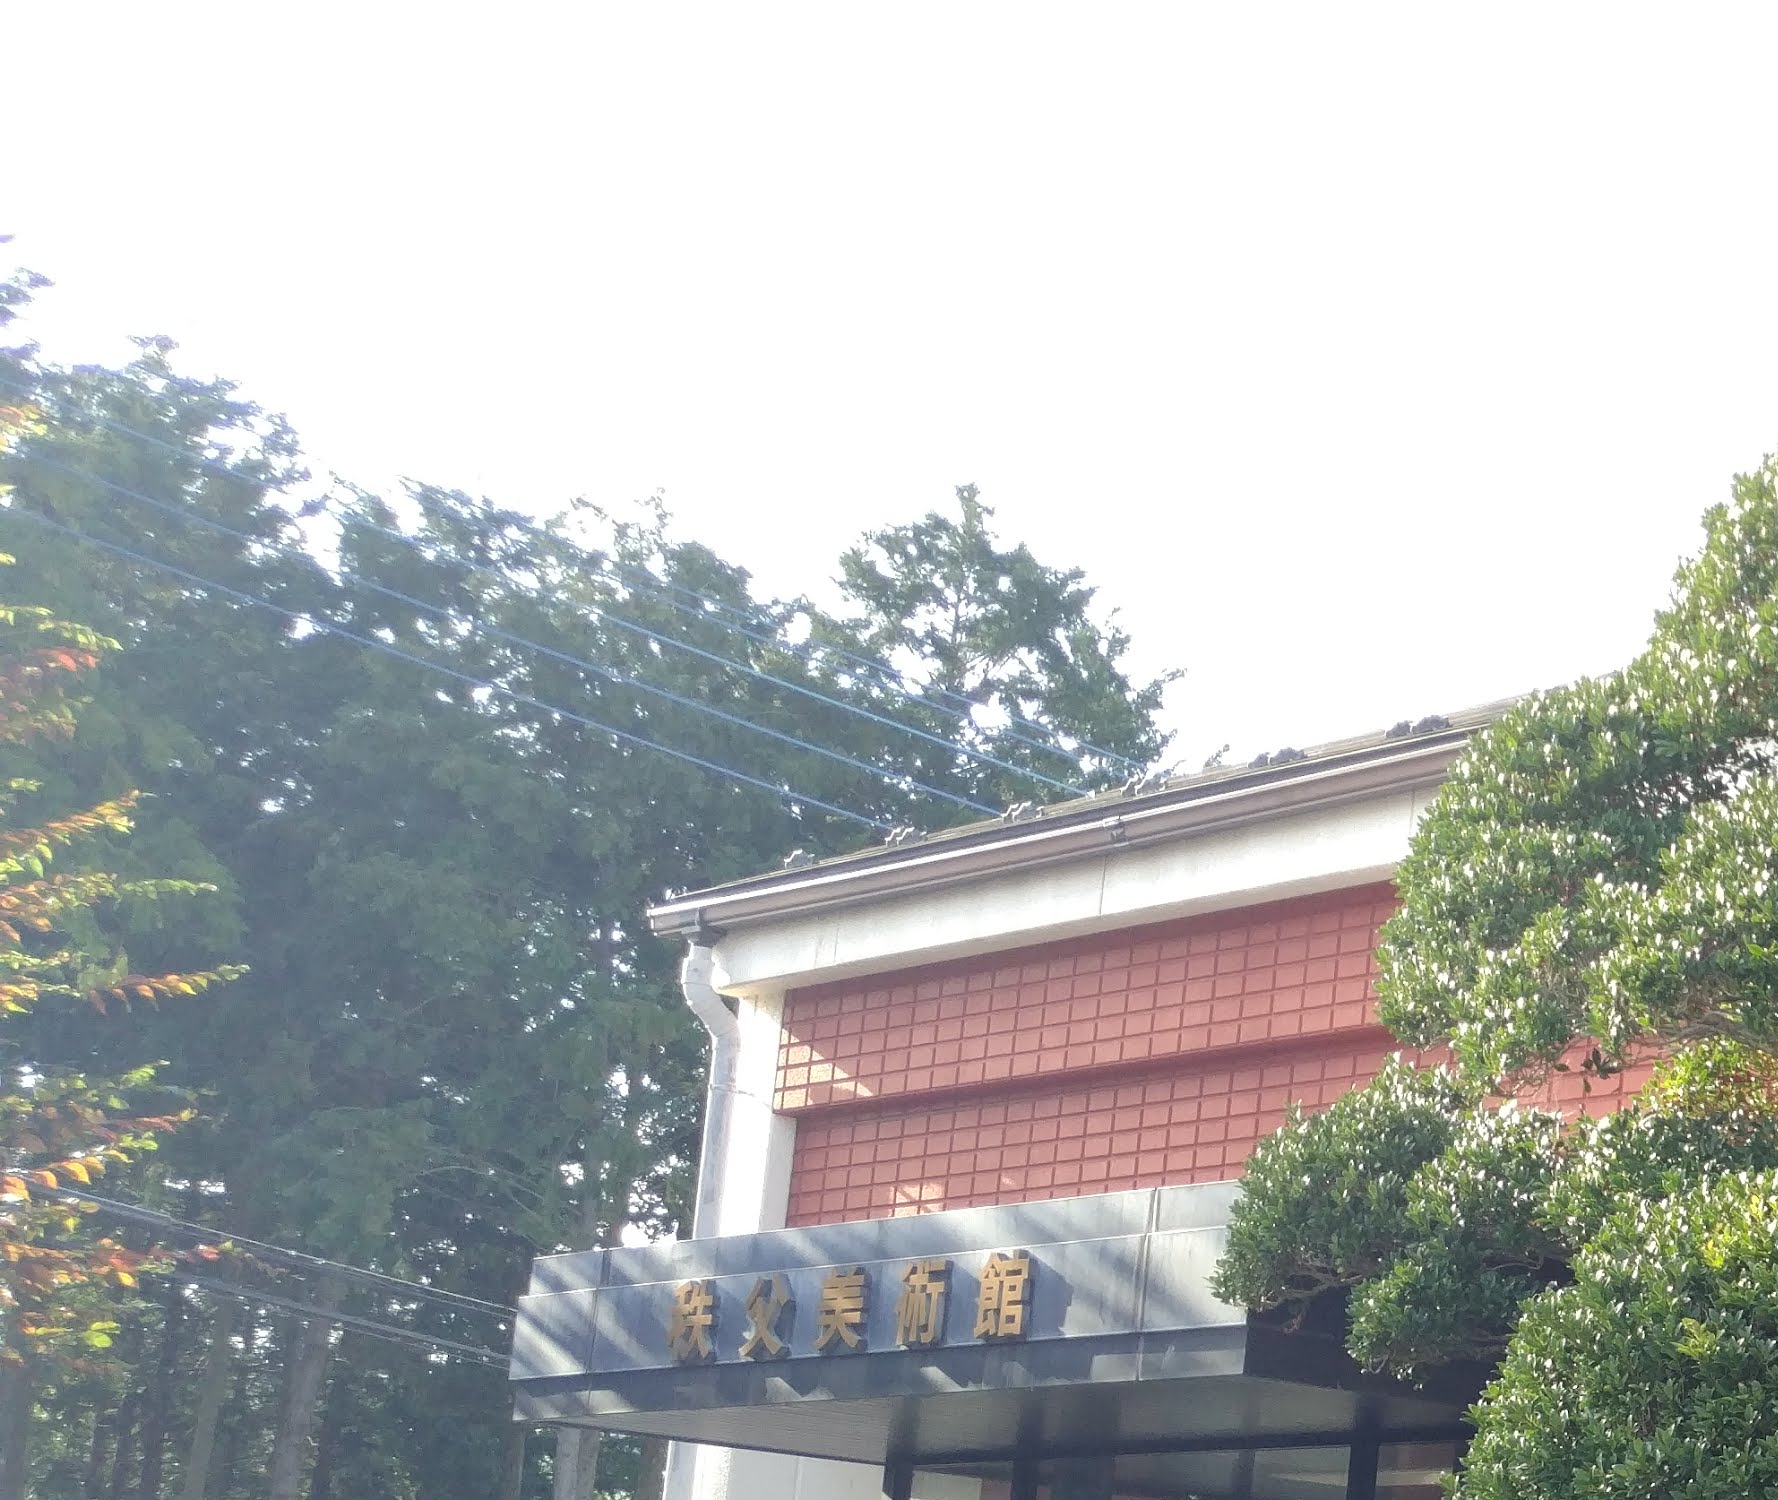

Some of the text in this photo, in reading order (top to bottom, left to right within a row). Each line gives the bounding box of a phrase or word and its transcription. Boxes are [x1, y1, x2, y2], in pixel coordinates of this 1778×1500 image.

[667, 1248, 1035, 1363] 秩父美術館
